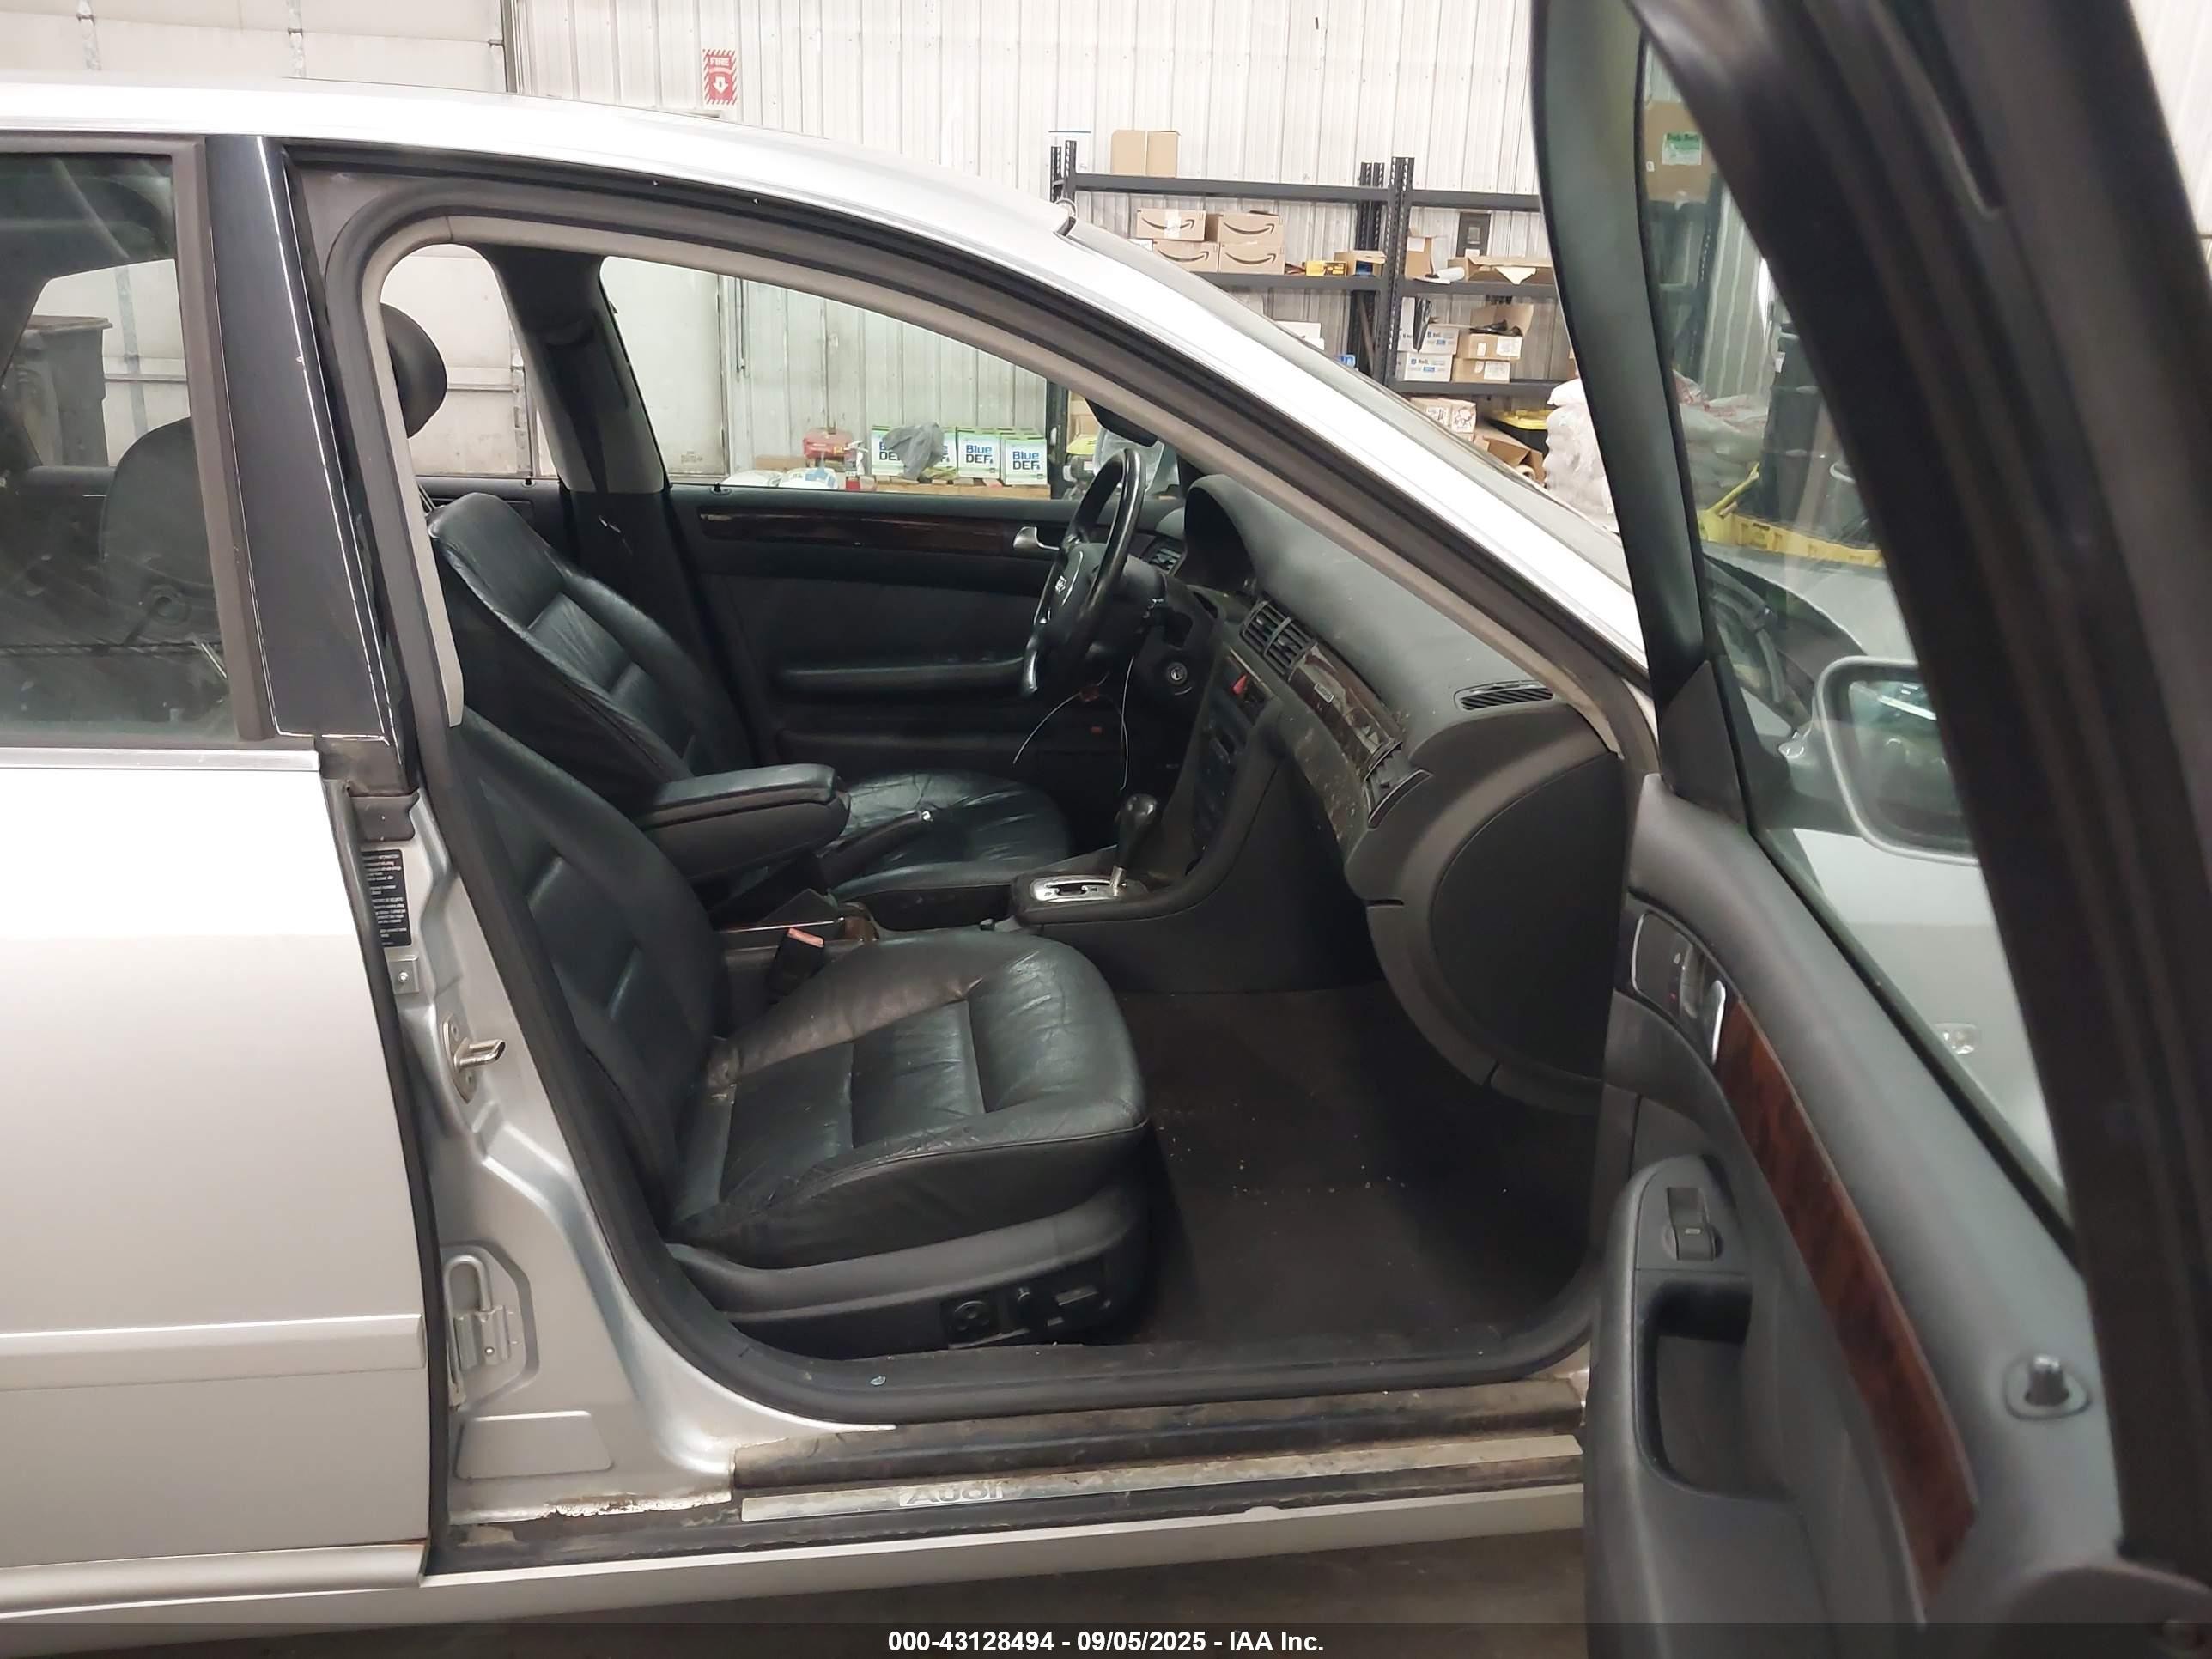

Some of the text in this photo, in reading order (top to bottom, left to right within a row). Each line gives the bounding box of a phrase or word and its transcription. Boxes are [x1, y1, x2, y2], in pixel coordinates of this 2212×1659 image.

[709, 57, 730, 67] FIRE
[966, 444, 993, 453] Blue
[879, 451, 900, 461] DE
[966, 453, 993, 464] DEF
[1013, 451, 1039, 460] Blue
[1013, 460, 1038, 470] DEF
